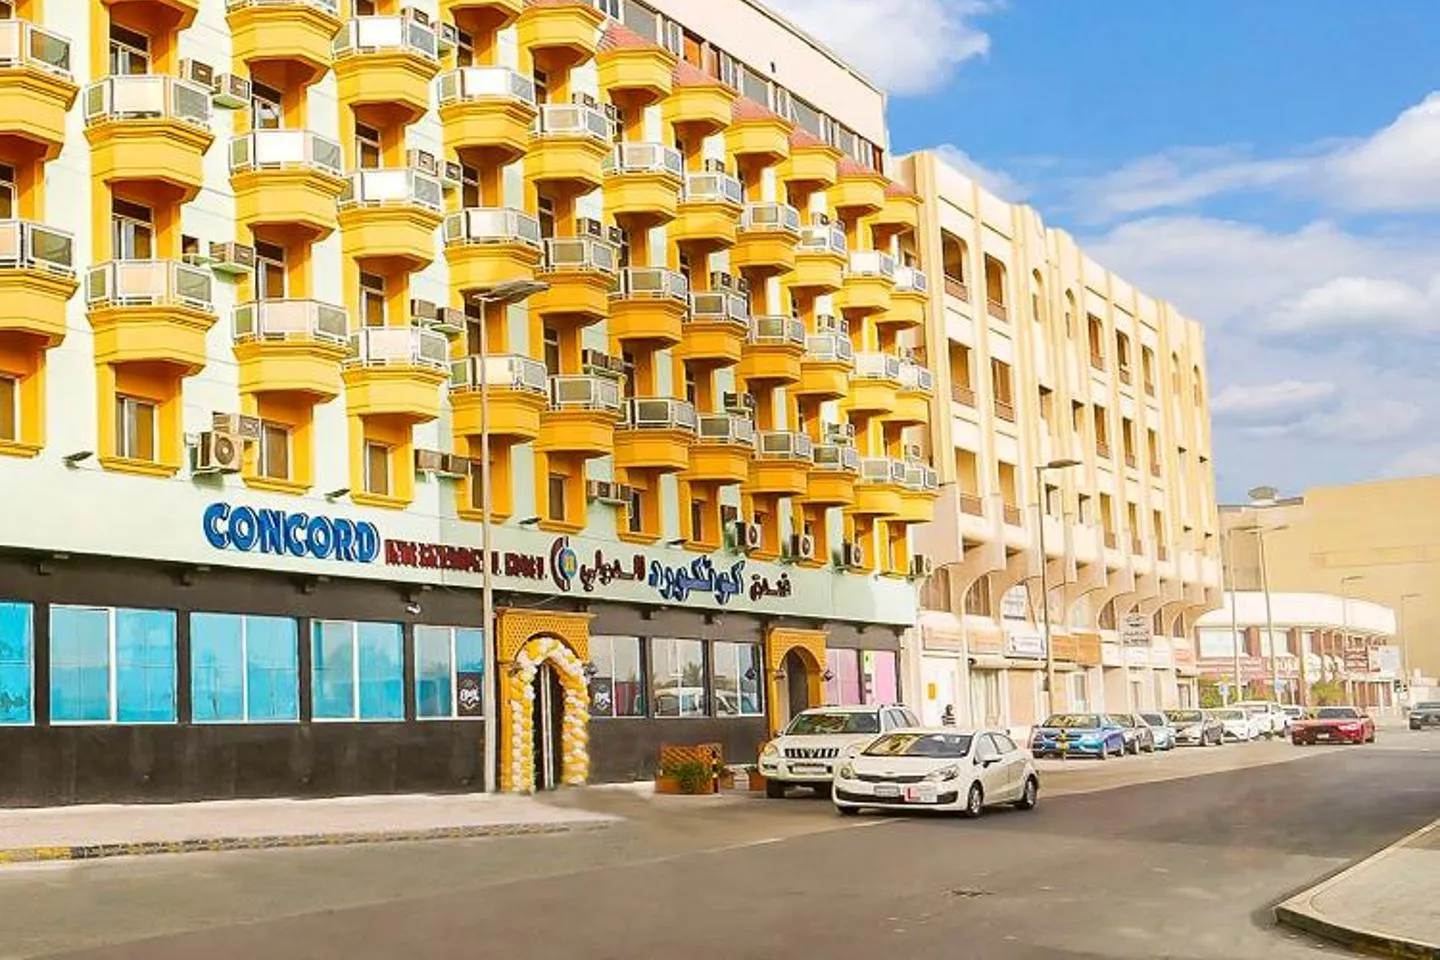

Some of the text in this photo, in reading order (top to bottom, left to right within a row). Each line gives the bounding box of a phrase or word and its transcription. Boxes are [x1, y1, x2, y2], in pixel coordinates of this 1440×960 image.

[203, 502, 380, 564] CONCORD
[384, 539, 500, 576] INTERNATIONL
[580, 550, 645, 591] الدولي
[750, 573, 792, 602] فندق
